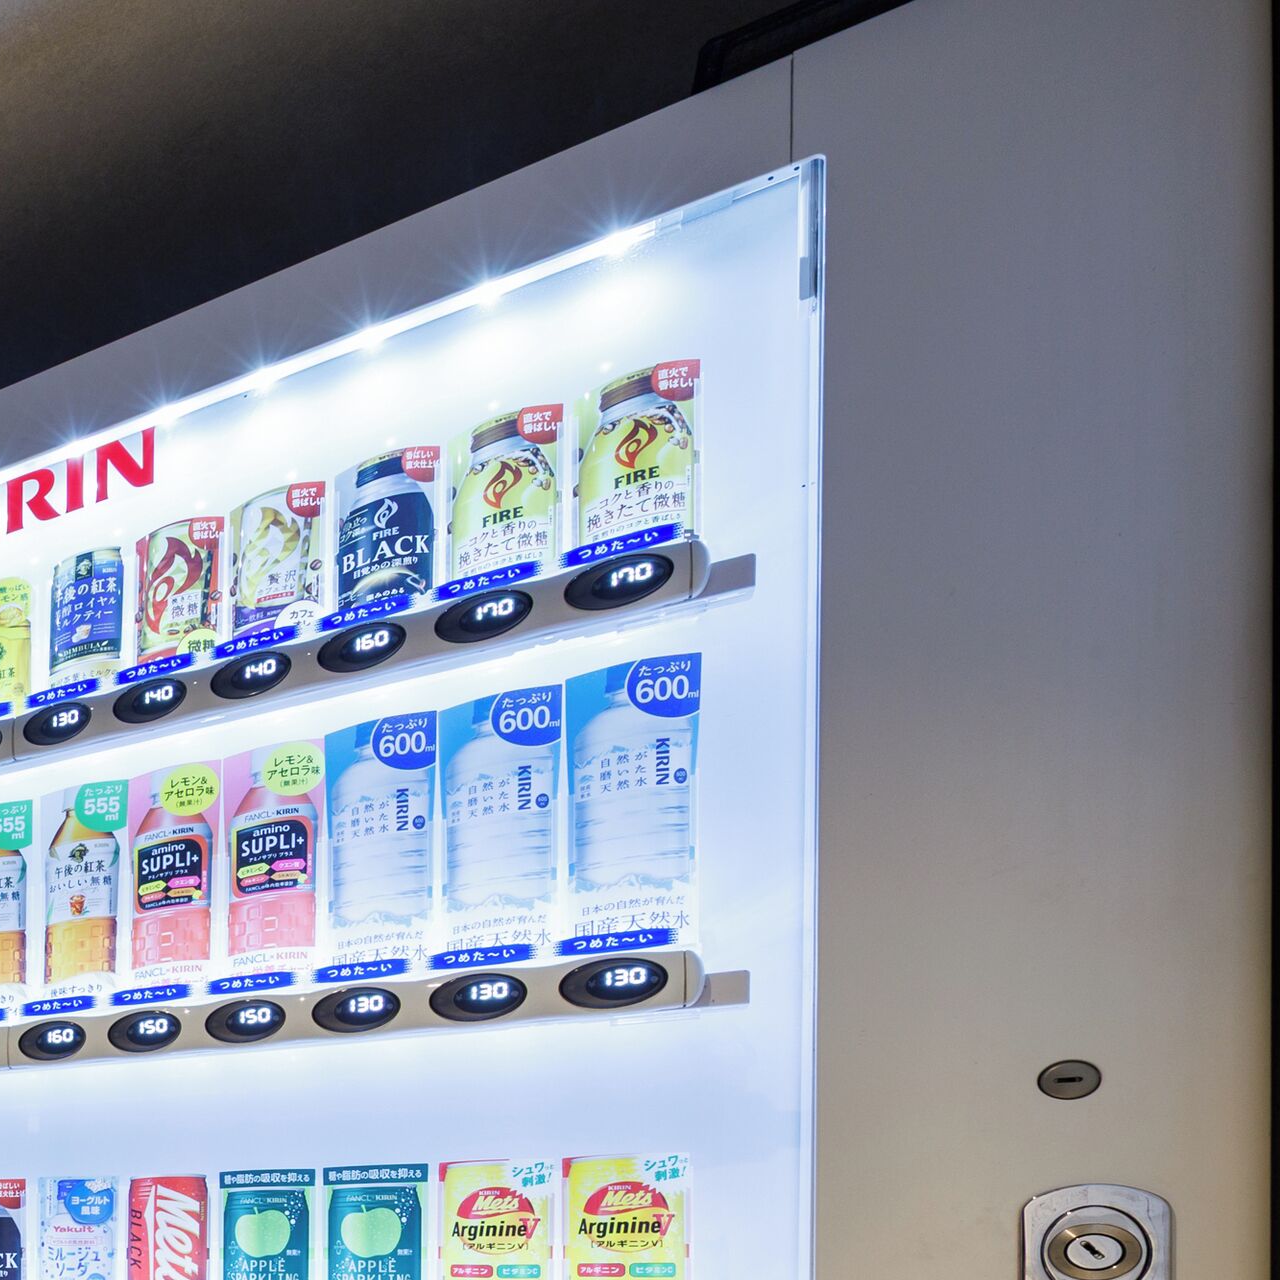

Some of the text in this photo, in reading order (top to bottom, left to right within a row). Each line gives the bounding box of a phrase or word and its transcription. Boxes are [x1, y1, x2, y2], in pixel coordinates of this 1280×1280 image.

[614, 467, 659, 489] FIRE
[482, 507, 523, 527] FIRE
[373, 527, 399, 541] FIRE
[342, 535, 429, 574] BLACK
[611, 563, 652, 587] 170
[356, 631, 389, 651] 160
[245, 660, 276, 678] 140
[639, 660, 691, 677] たっぷり
[635, 675, 699, 703] 600 ml
[502, 692, 552, 709] たっぷり
[53, 710, 79, 727] 130
[381, 718, 428, 734] たっぷり
[499, 707, 560, 733] 600 ml
[379, 735, 435, 757] 600 ml
[656, 738, 670, 785] KIRIN
[84, 785, 123, 797] たっぷり
[164, 786, 215, 800] アセロラ味
[518, 764, 532, 811] KIRIN
[84, 796, 120, 815] 555
[396, 787, 409, 832] KIRIN
[252, 823, 290, 837] amino
[151, 842, 185, 856] amino
[241, 832, 304, 857] SUPLI+
[55, 860, 106, 878] 午後の紅茶
[141, 851, 199, 875] SUPLI+
[605, 968, 646, 986] 130
[350, 996, 383, 1013] 130
[240, 1009, 271, 1024] 150
[48, 1029, 74, 1044] 160
[53, 1225, 95, 1234] Yakult
[452, 1218, 540, 1240] Arginine V
[579, 1214, 674, 1238] Arginine V
[130, 1209, 142, 1269] BLACK
[241, 1260, 285, 1272] APPLE
[348, 1260, 396, 1272] APPLE
